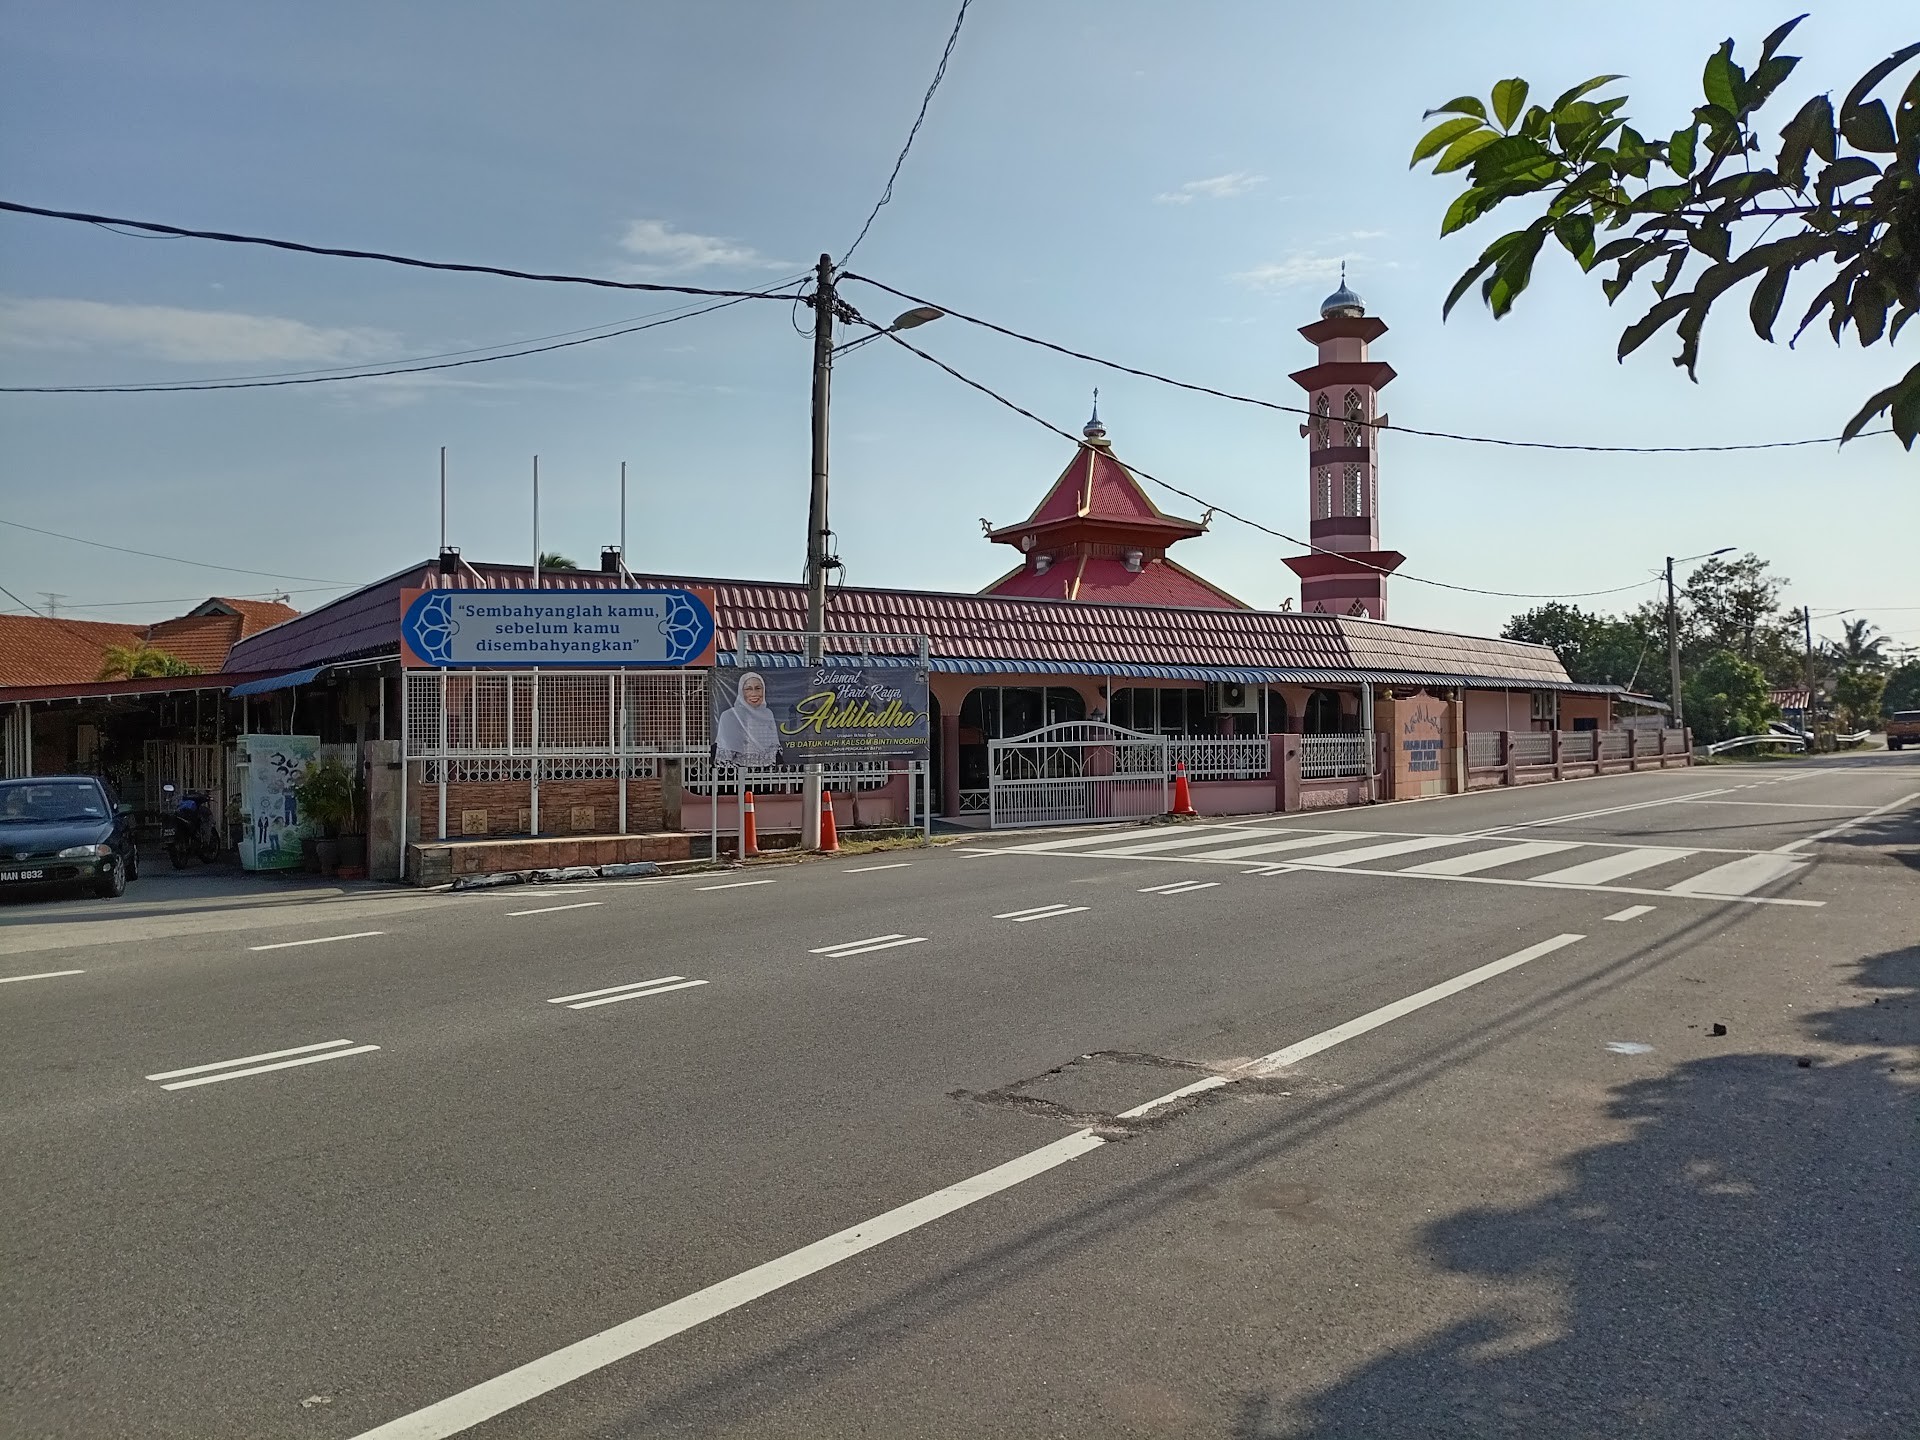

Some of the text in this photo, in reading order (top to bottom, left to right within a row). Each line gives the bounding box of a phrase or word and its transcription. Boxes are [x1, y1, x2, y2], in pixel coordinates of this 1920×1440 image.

[607, 604, 660, 619] kamu,
[495, 622, 621, 635] sebelum kamu
[812, 669, 862, 686] Selamat
[837, 684, 902, 702] Hari Raya
[779, 691, 930, 736] Aidiladha
[785, 741, 796, 749] YB
[797, 740, 823, 748] DATUK
[893, 737, 928, 745] NOORDIN
[0, 871, 19, 881] MAN
